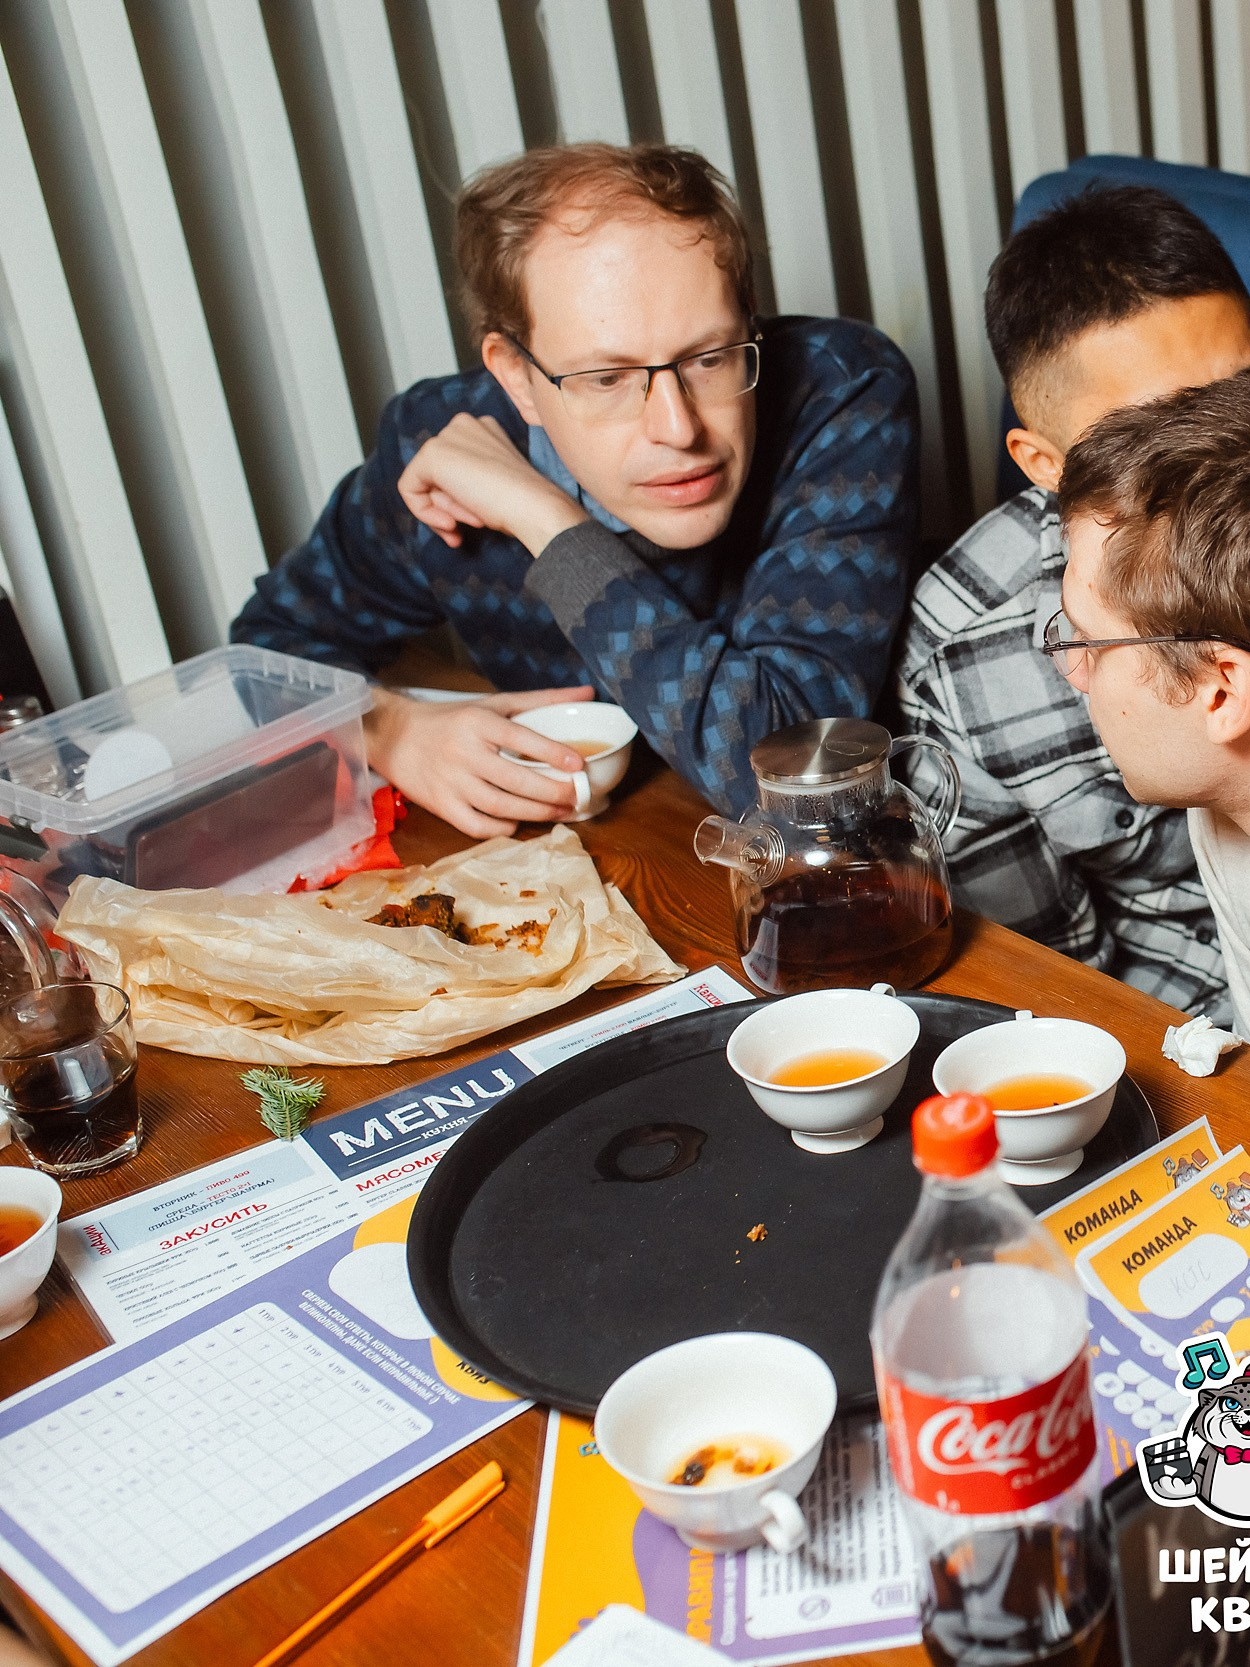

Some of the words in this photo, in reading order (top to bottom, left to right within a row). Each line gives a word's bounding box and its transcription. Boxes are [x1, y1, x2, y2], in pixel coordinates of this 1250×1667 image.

[329, 1068, 516, 1157] MENU
[421, 1116, 469, 1139] КУХНЯ
[152, 1190, 197, 1213] ВТОРНИК
[205, 1176, 231, 1191] ПИВО
[356, 1149, 451, 1192] МЯСОМЕ
[159, 1199, 268, 1251] ЗАКУСИТЬ
[165, 1201, 198, 1219] СРЕДА
[206, 1186, 237, 1202] ТЕСТО
[1064, 1189, 1144, 1245] КОМАНДА
[1122, 1216, 1198, 1275] КОМАНДА
[301, 1288, 332, 1311] СВЕРЯЕМ
[327, 1308, 349, 1324] СВОИ
[370, 1339, 404, 1365] КОТОРЫЕ
[430, 1383, 460, 1405] СЛУЧАЕ
[342, 1334, 366, 1352] ДАЖЕ
[361, 1347, 383, 1363] ЕСЛИ
[687, 1548, 714, 1646] РАВИЛ
